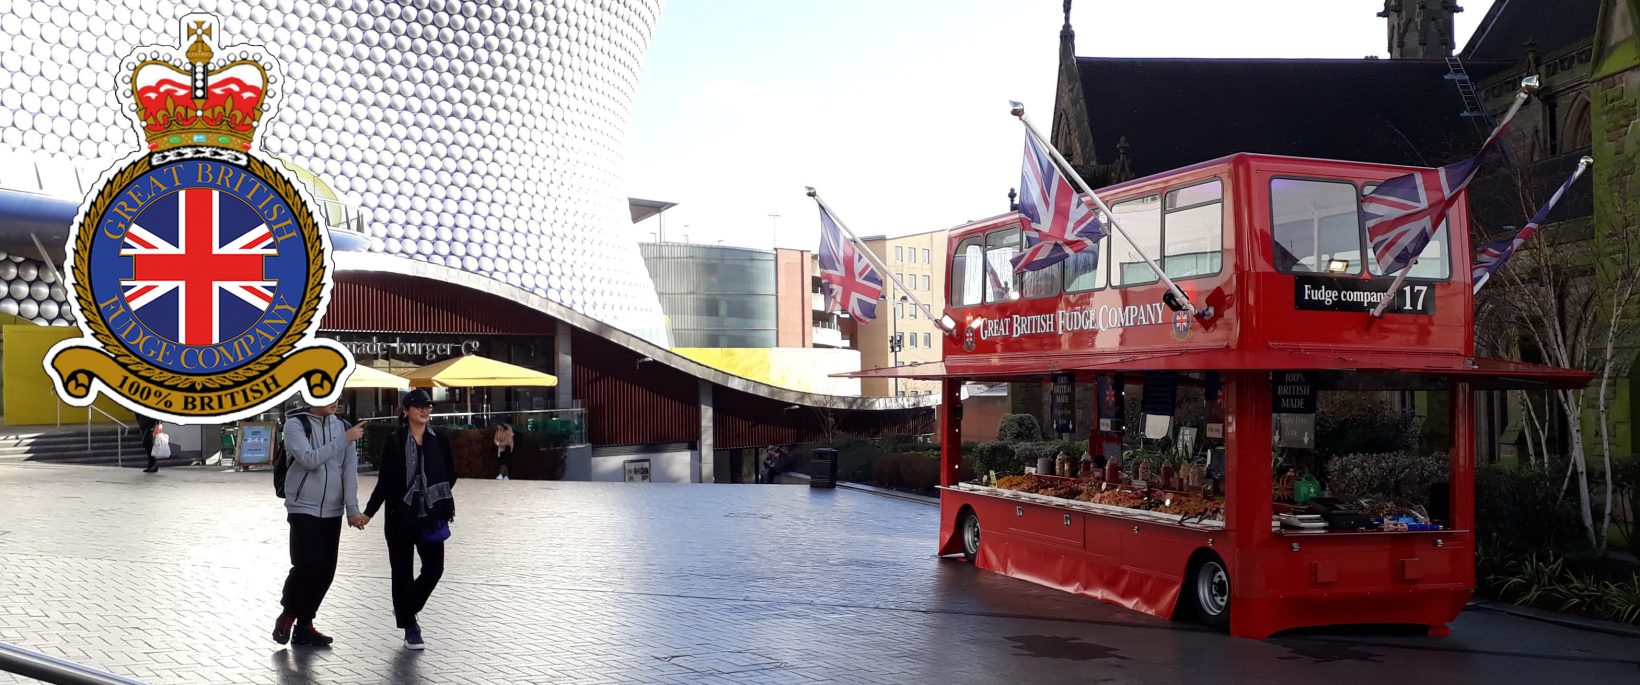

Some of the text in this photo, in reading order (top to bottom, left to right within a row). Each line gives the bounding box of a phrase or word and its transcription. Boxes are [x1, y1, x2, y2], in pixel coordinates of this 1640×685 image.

[1304, 284, 1389, 307] Fudge compan
[1402, 285, 1428, 311] 17
[979, 302, 1166, 341] GREAT BRITISH FUDGE COMPANY
[396, 336, 451, 360] burger
[1277, 384, 1310, 396] BRITISH
[1281, 398, 1305, 409] MADE
